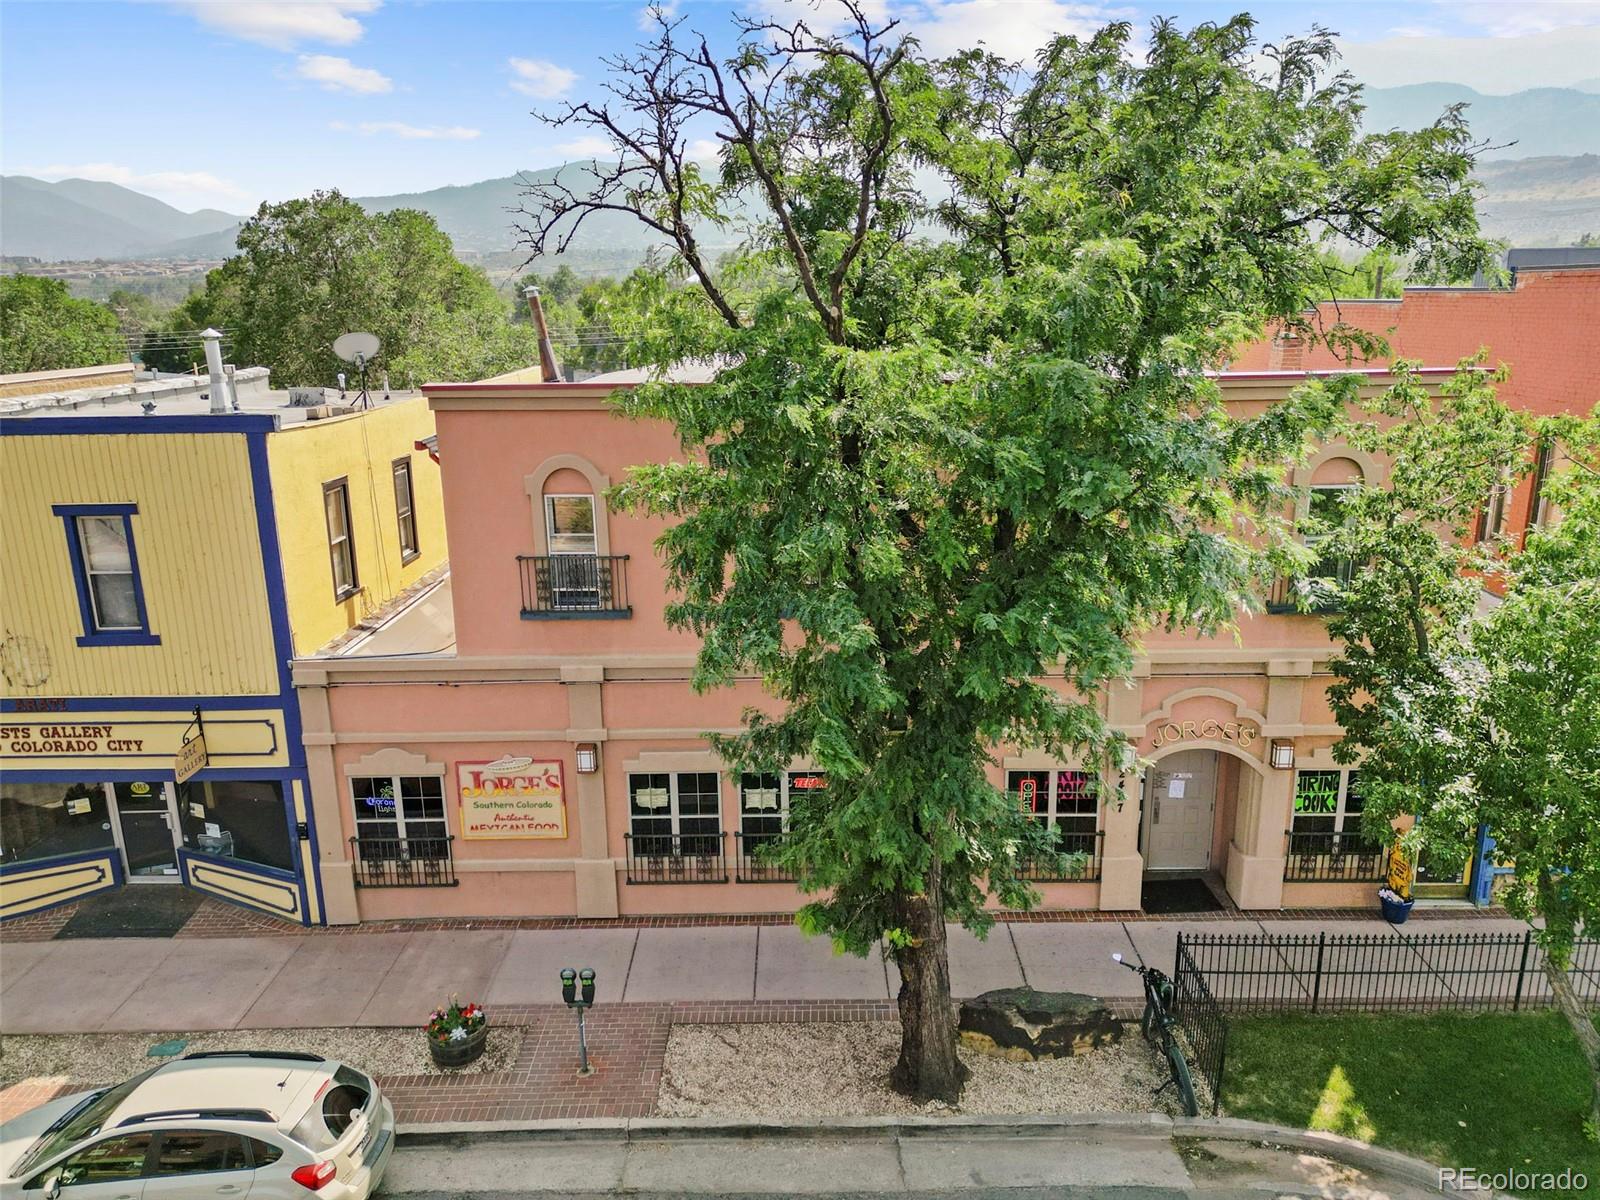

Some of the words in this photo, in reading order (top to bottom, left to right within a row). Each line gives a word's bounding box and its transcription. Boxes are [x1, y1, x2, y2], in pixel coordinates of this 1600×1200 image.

[40, 726, 113, 739] GALLERY
[1152, 719, 1255, 747] JORGE'S
[10, 740, 98, 752] COLORADO
[107, 740, 143, 752] CITY
[366, 797, 395, 806] Coron
[473, 801, 514, 809] Southern
[516, 801, 553, 809] Colorado
[494, 813, 534, 822] Authentic
[527, 823, 560, 831] FOOD
